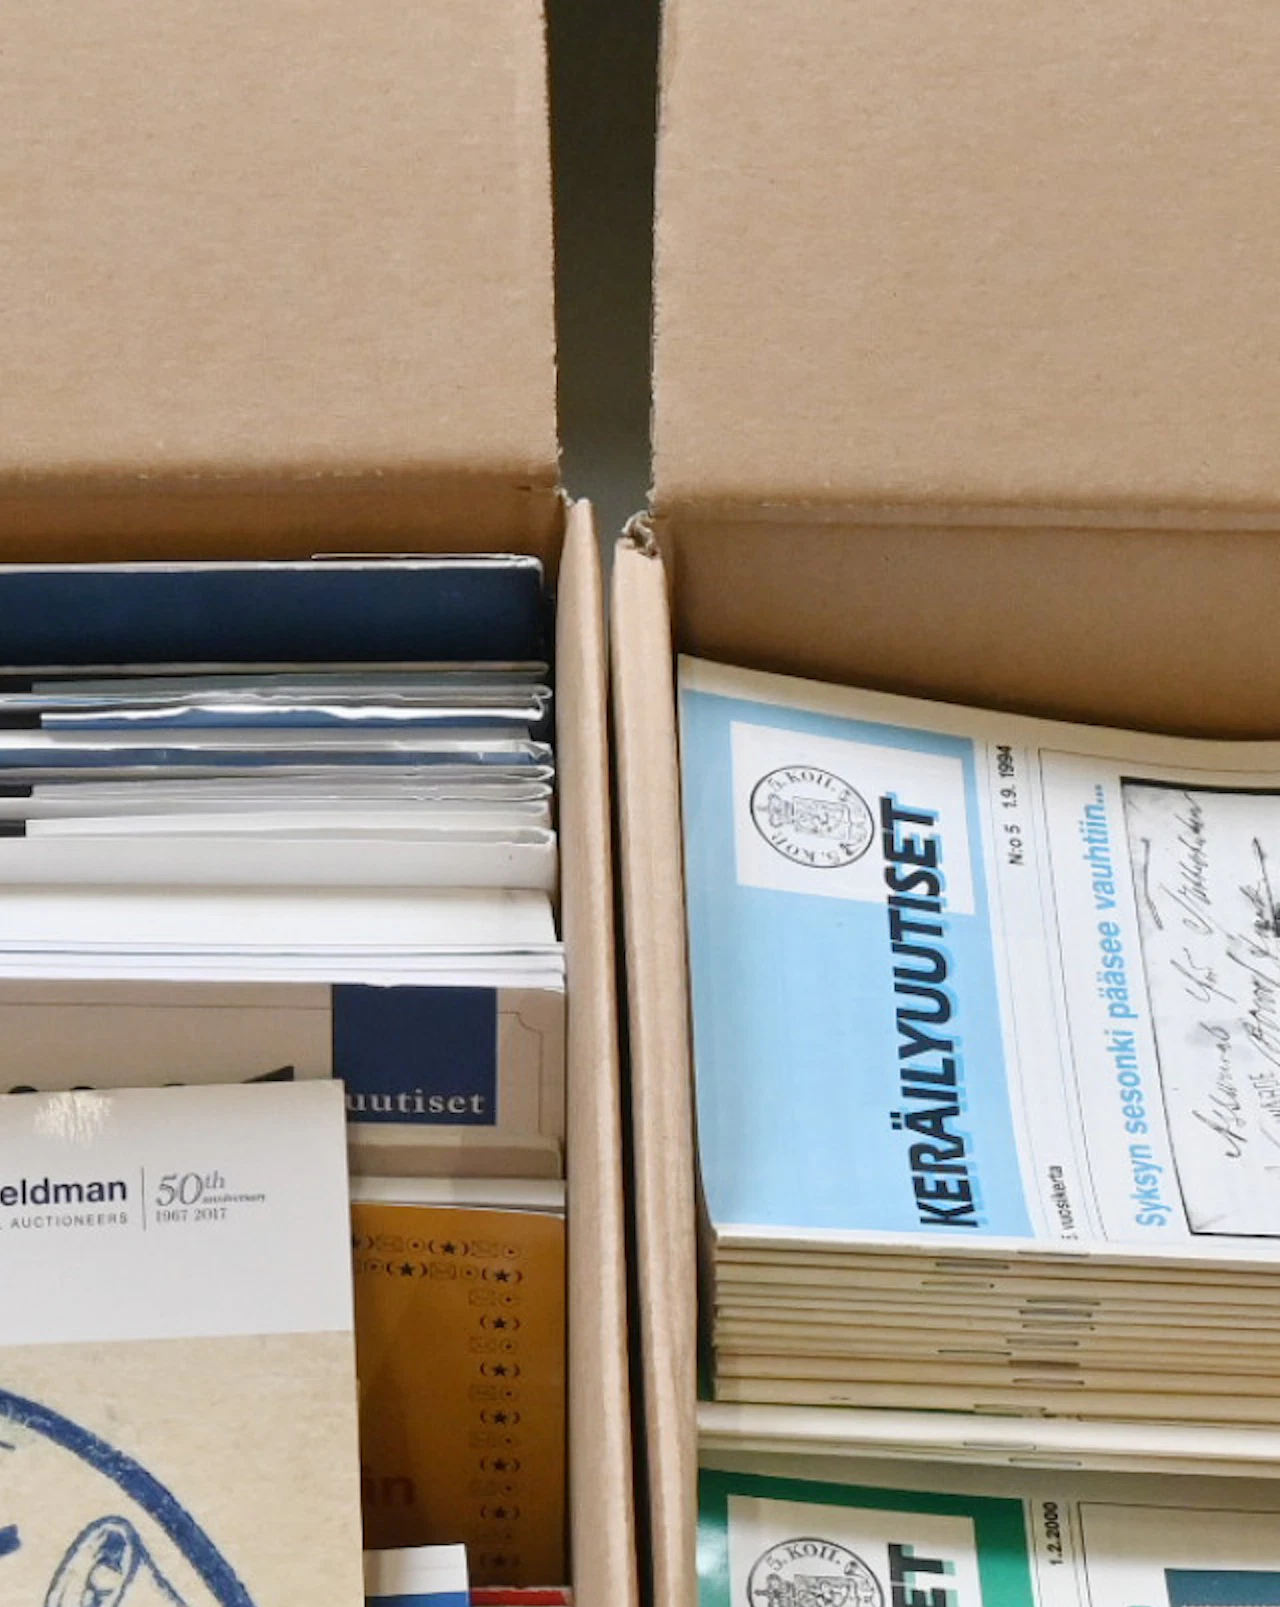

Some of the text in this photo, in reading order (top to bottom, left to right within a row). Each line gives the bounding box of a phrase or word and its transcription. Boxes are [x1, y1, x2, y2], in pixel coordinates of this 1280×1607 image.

[995, 745, 1015, 778] 1994
[1005, 824, 1020, 835] 5
[1005, 837, 1024, 865] N:o
[880, 796, 980, 1228] KERÄILYUUTISET
[1078, 784, 1172, 1228] Syksyn sesonki pääsee vauhtiin...
[155, 1169, 227, 1207] 50th
[9, 1211, 129, 1230] AUCTIONEERS
[155, 1205, 228, 1223] 1967 2017
[1042, 1502, 1064, 1566] 1.2.2000
